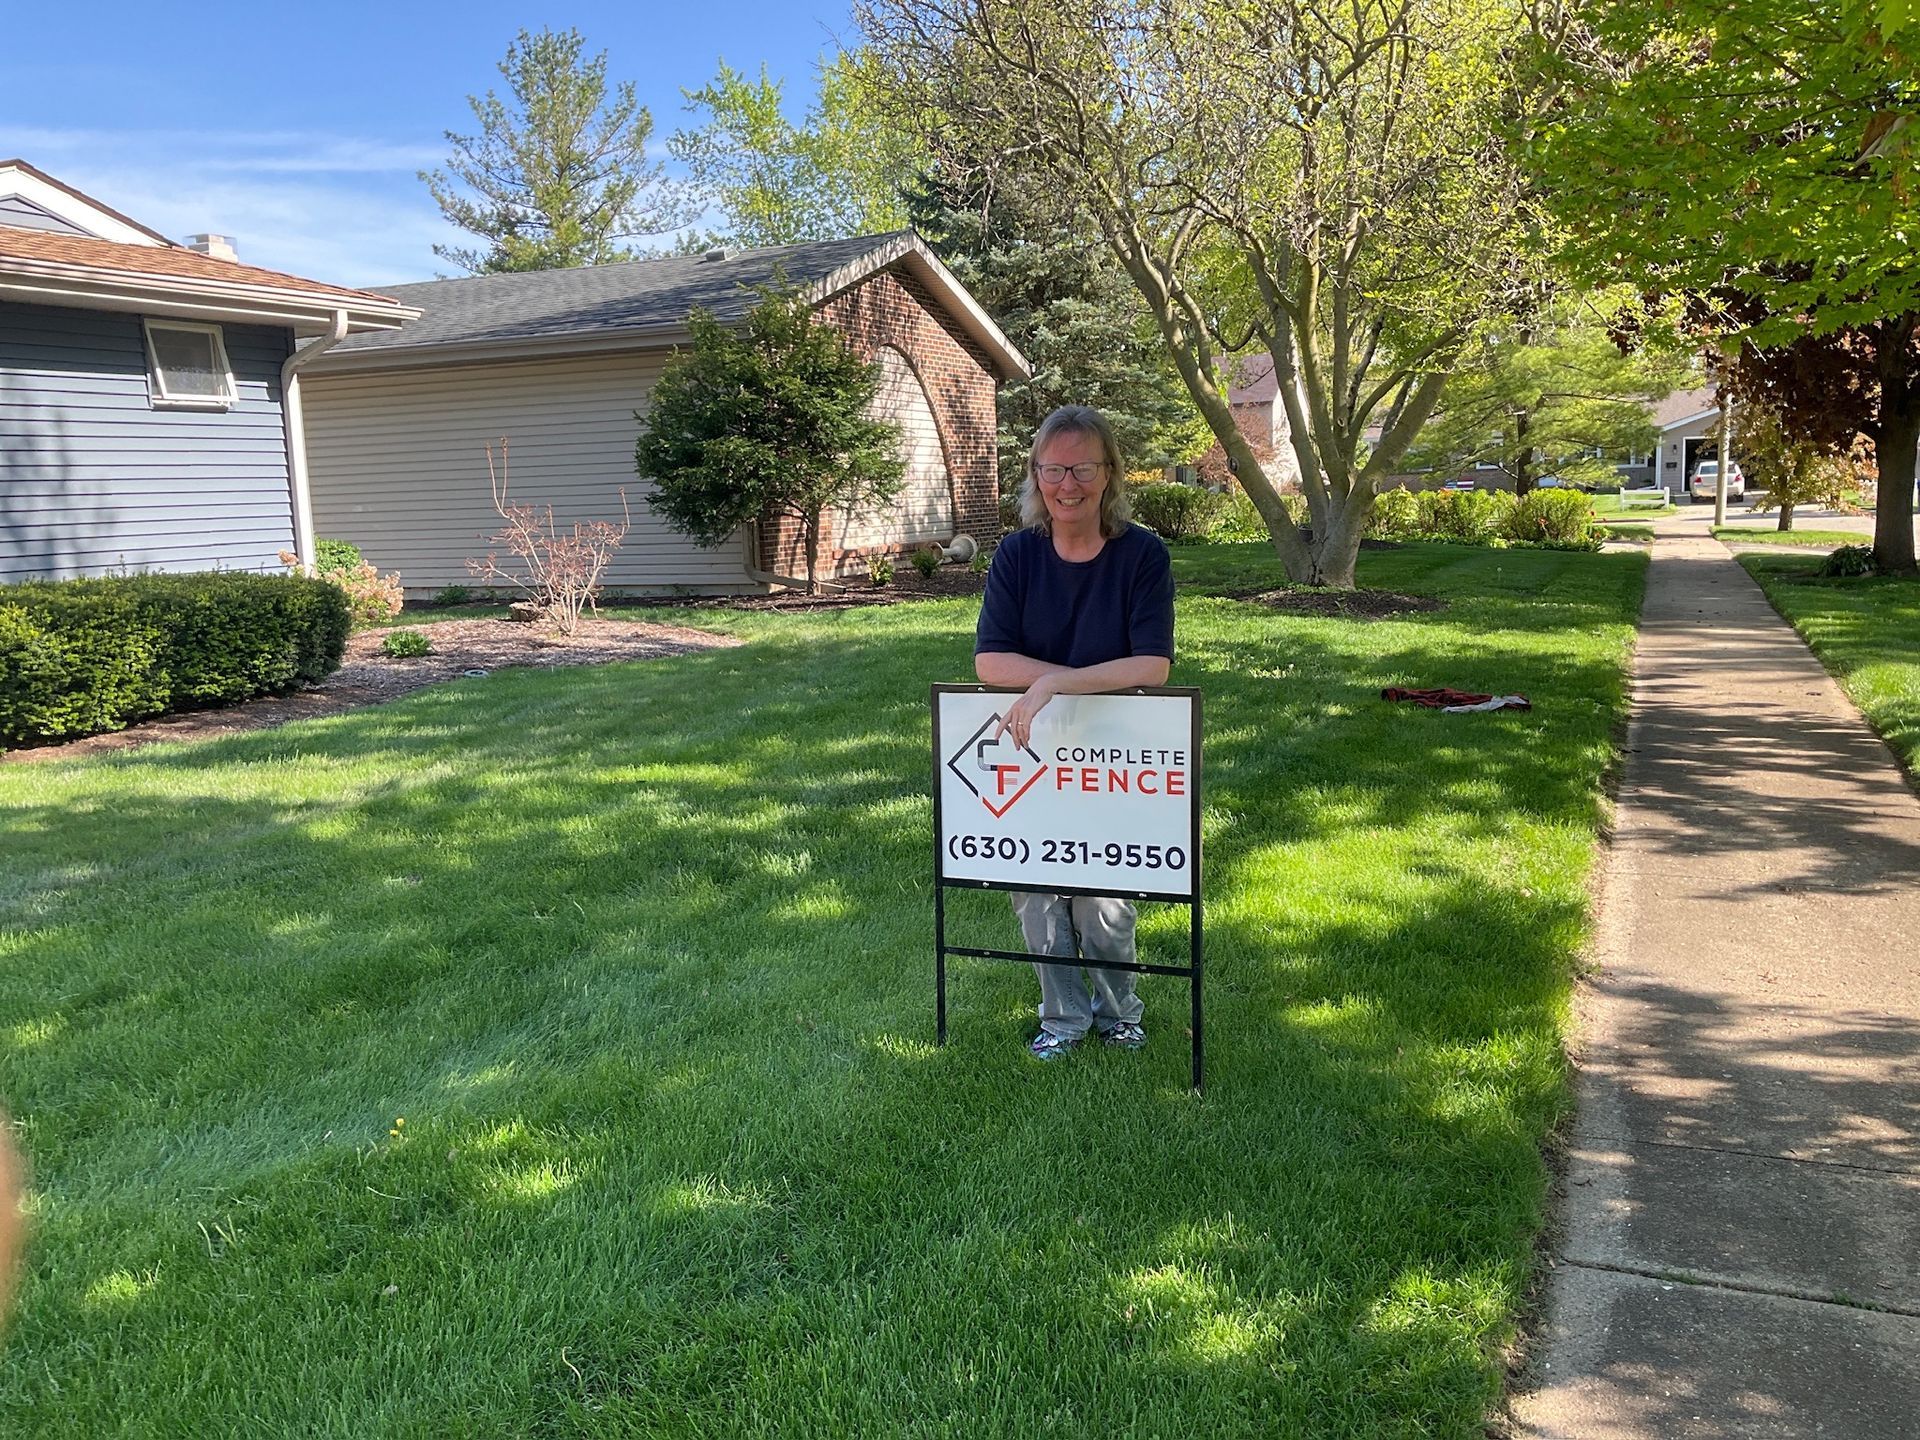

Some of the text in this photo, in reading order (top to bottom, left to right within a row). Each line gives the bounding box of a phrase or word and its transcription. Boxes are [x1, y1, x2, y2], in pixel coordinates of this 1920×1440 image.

[1055, 747, 1185, 766] COMPLETE
[1056, 767, 1185, 796] FENCE
[948, 834, 1186, 870] (630) 231-9550
